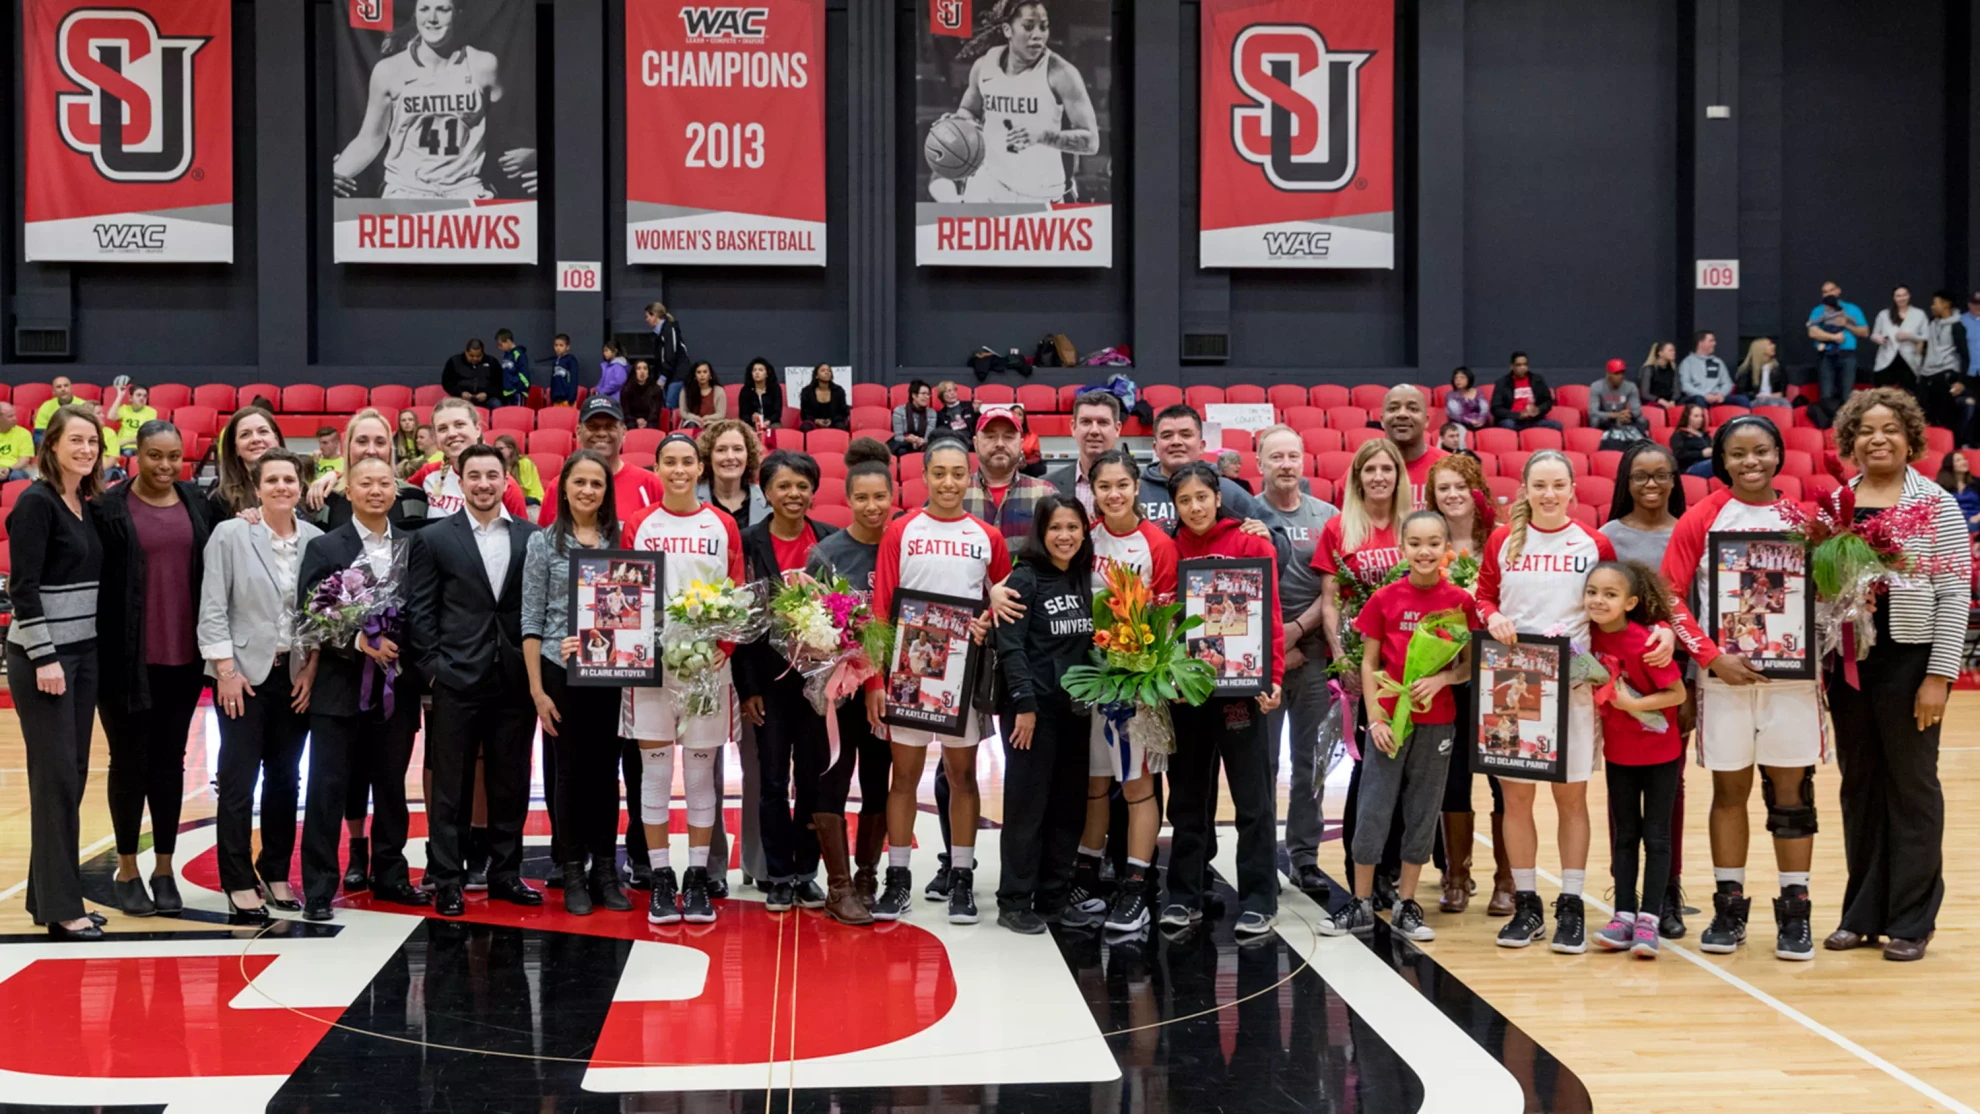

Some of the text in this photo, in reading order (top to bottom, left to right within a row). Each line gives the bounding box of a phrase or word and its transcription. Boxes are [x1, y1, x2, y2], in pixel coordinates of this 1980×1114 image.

[679, 7, 768, 37] WAC
[642, 50, 808, 88] CHAMPIONS
[418, 116, 460, 156] 41
[685, 121, 765, 169] 2013
[93, 223, 167, 249] WAC
[358, 213, 521, 250] REDHAWKS
[635, 229, 816, 251] WOMEN'S BASKETBALL
[937, 216, 1093, 251] REDHAWKS
[1262, 231, 1332, 255] WAC
[563, 269, 595, 288] 108
[1703, 267, 1733, 286] 109
[644, 537, 719, 556] SEATTLEU
[908, 538, 982, 560] SEATTLEU
[1404, 611, 1421, 621] MY
[589, 668, 613, 676] CLAIRE
[614, 669, 646, 677] METOYER
[895, 707, 947, 722] #2 KAYLEE BEST
[1484, 756, 1550, 770] #21 DELANIE PARRY
